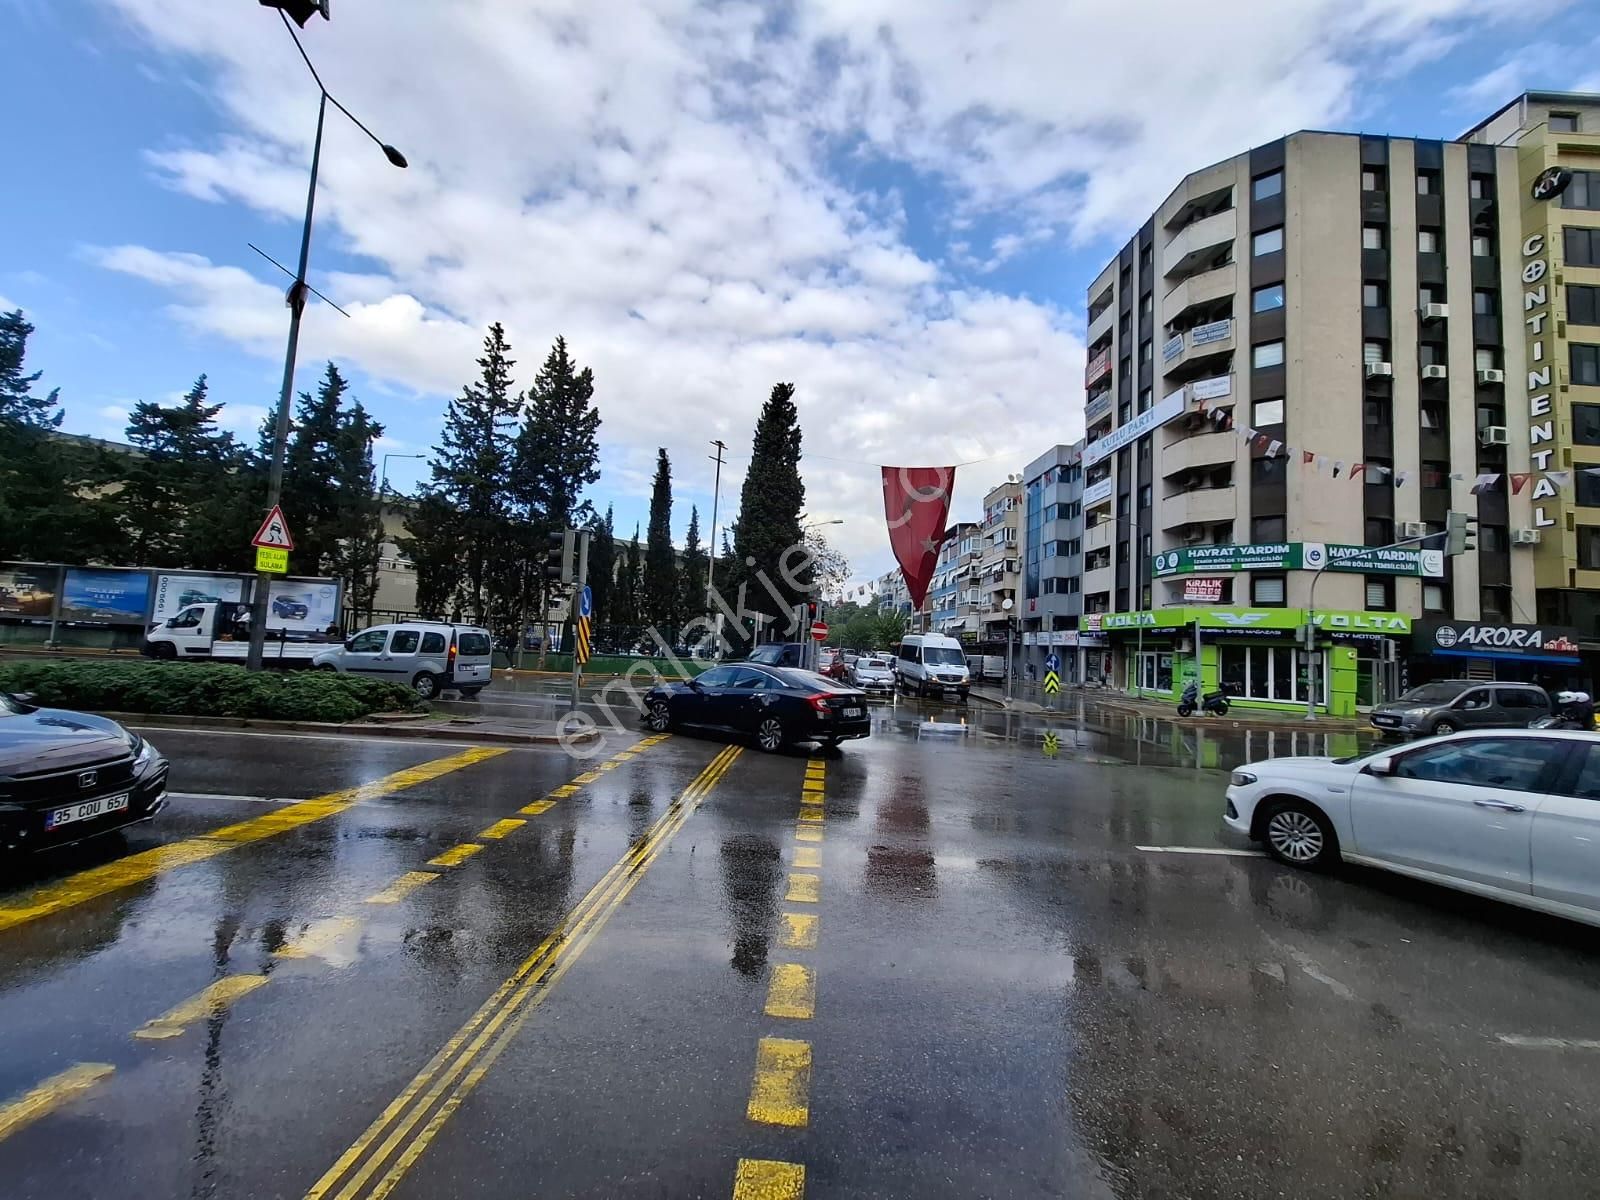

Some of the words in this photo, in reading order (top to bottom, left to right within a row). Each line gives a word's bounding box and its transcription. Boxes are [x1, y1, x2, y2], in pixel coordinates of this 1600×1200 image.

[1522, 234, 1556, 527] CONTINENTAL
[1101, 427, 1126, 449] KUTLU
[1188, 547, 1236, 558] HAYRAT
[1239, 545, 1290, 555] YARDIM
[1329, 547, 1372, 559] HAYRAT
[1376, 550, 1420, 561] YARDIM
[1106, 613, 1156, 627] VOLTA
[1306, 612, 1408, 630] VOLTA
[1458, 626, 1542, 648] ARORA
[55, 809, 71, 823] 35
[107, 795, 129, 809] 657
